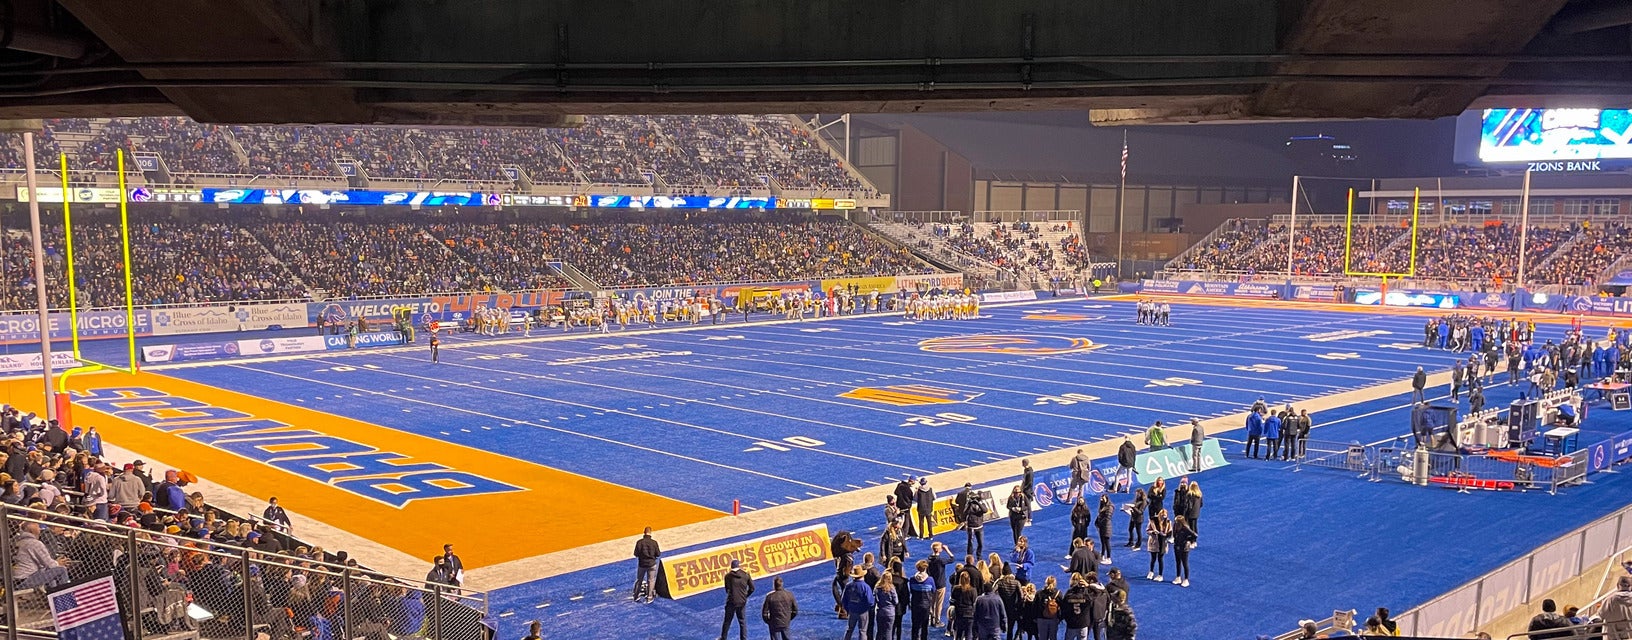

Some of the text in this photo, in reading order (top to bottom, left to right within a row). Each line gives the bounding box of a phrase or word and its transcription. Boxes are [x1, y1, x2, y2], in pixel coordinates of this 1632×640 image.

[1528, 161, 1601, 171] ZIONS BANK
[652, 290, 672, 299] JOIN
[674, 289, 692, 298] THE
[251, 306, 269, 315] Blue
[423, 302, 440, 313] TO
[172, 311, 191, 319] Blue
[251, 311, 302, 322] Cross of Idaho
[173, 317, 228, 326] Cross of Idaho
[328, 332, 403, 346] CAMNG WORLD
[1038, 393, 1101, 405] 30
[906, 412, 978, 426] 20
[72, 386, 530, 509] BRONCOS
[753, 436, 826, 451] 10
[763, 535, 813, 554] GROWN IN
[765, 543, 822, 568] IDAHO
[673, 547, 757, 578] FAMOUS
[676, 561, 760, 591] POTATES
[1073, 603, 1081, 615] 5
